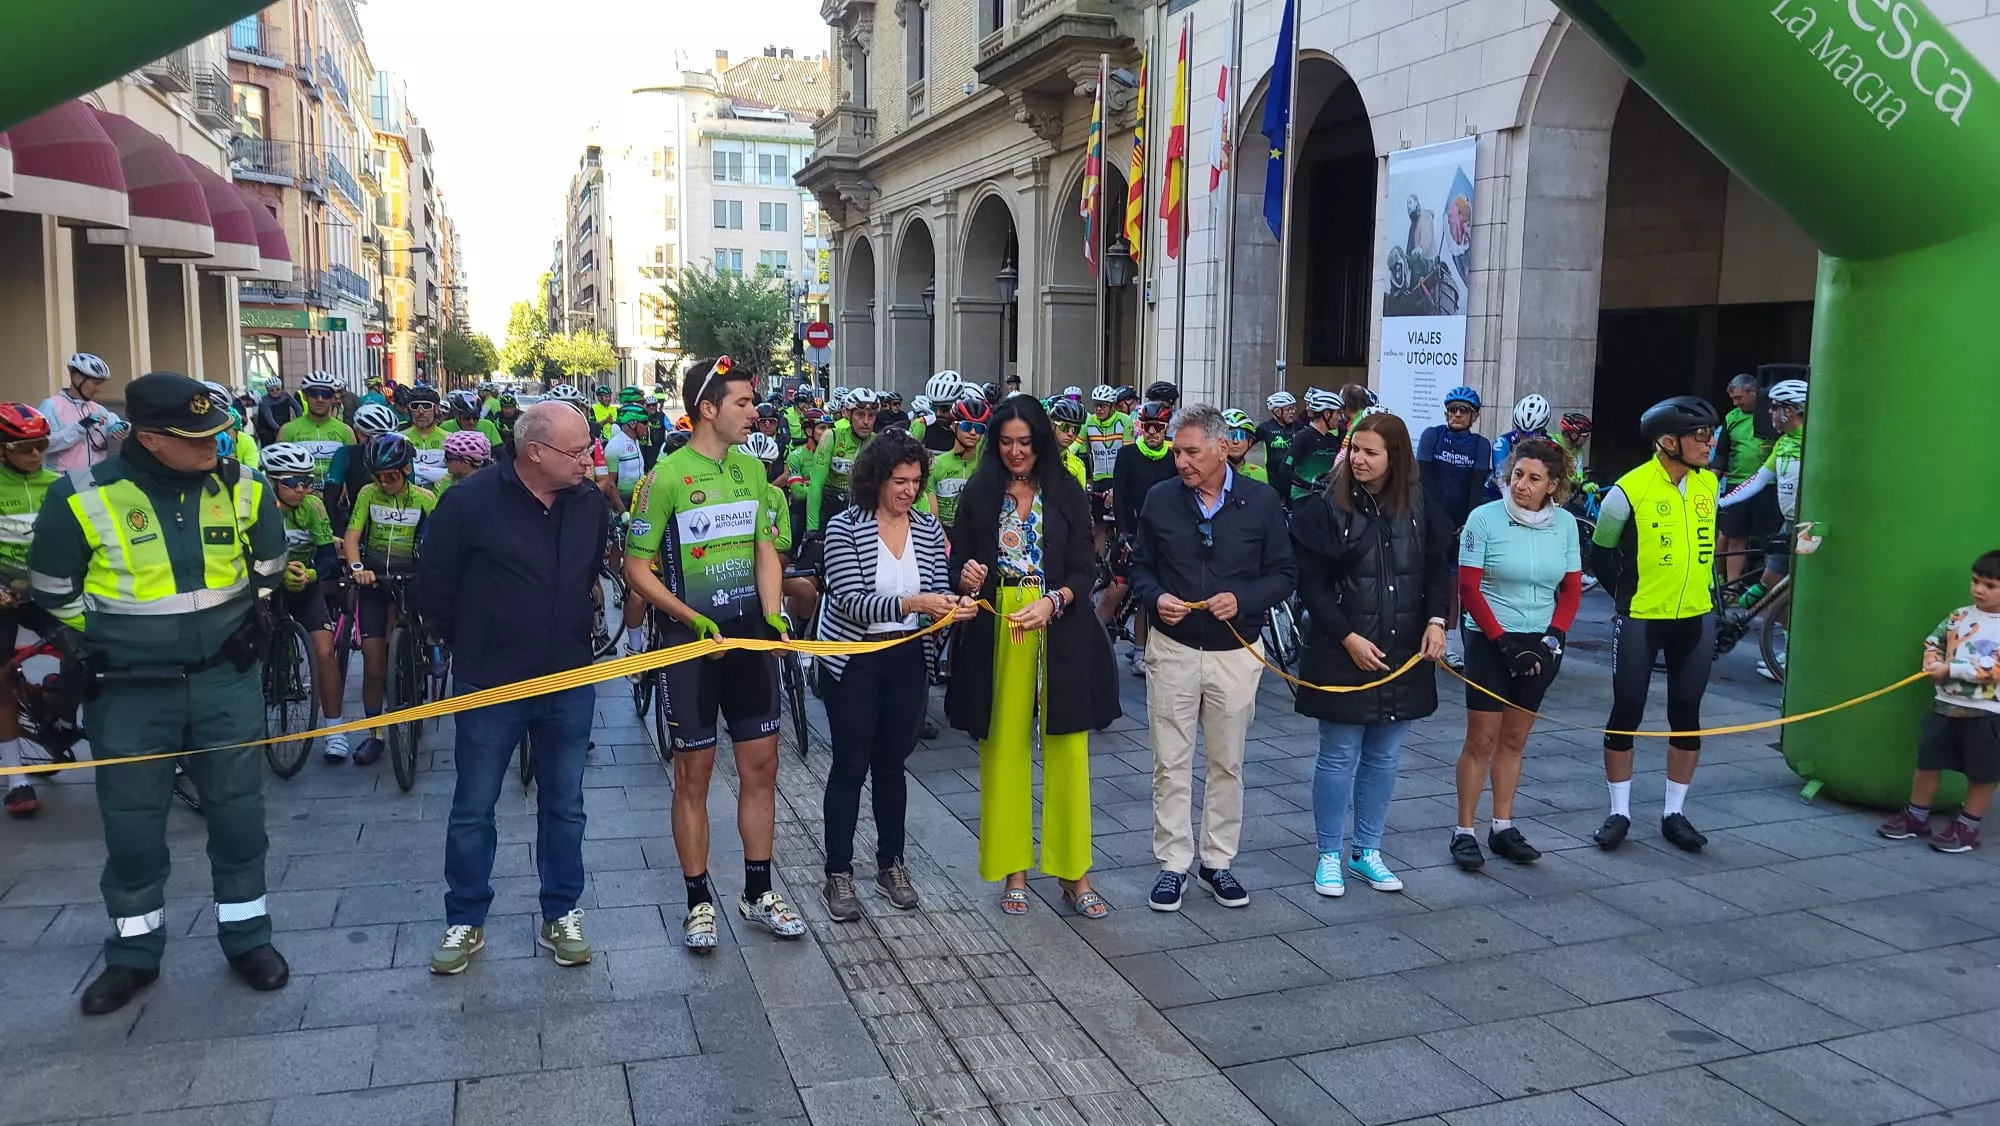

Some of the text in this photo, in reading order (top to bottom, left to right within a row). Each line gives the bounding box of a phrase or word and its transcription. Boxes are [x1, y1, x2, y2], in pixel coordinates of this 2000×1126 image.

[1848, 0, 1972, 127] esca
[1408, 331, 1442, 345] VIAJES
[1406, 348, 1458, 366] UTÓPICOS
[714, 511, 753, 523] RENAULT
[660, 672, 673, 716] RENAULT
